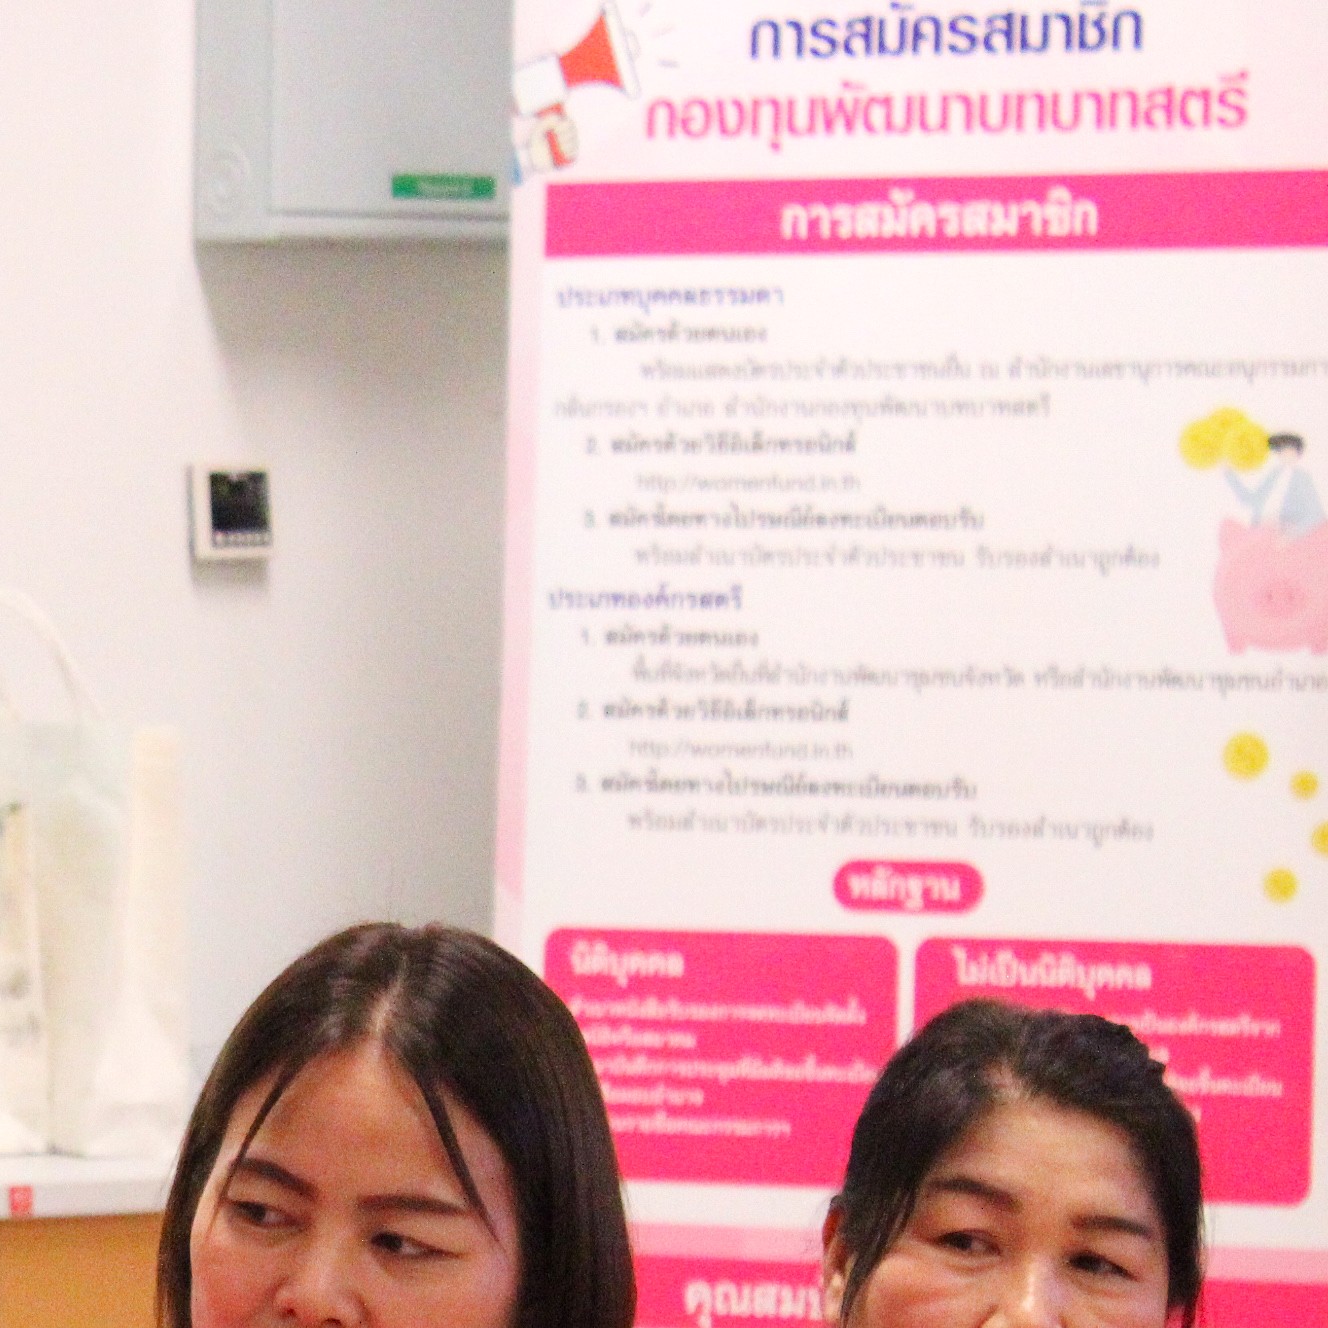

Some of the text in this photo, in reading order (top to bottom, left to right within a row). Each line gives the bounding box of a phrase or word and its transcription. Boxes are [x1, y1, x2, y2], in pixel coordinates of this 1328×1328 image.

[750, 1, 1144, 59] การสมัครสมาชิก
[644, 70, 1249, 152] กองทุนพัฒนาบทบาทสตรี
[781, 185, 1098, 239] การสมัครสมาชิก
[846, 864, 962, 913] หลักฐาน
